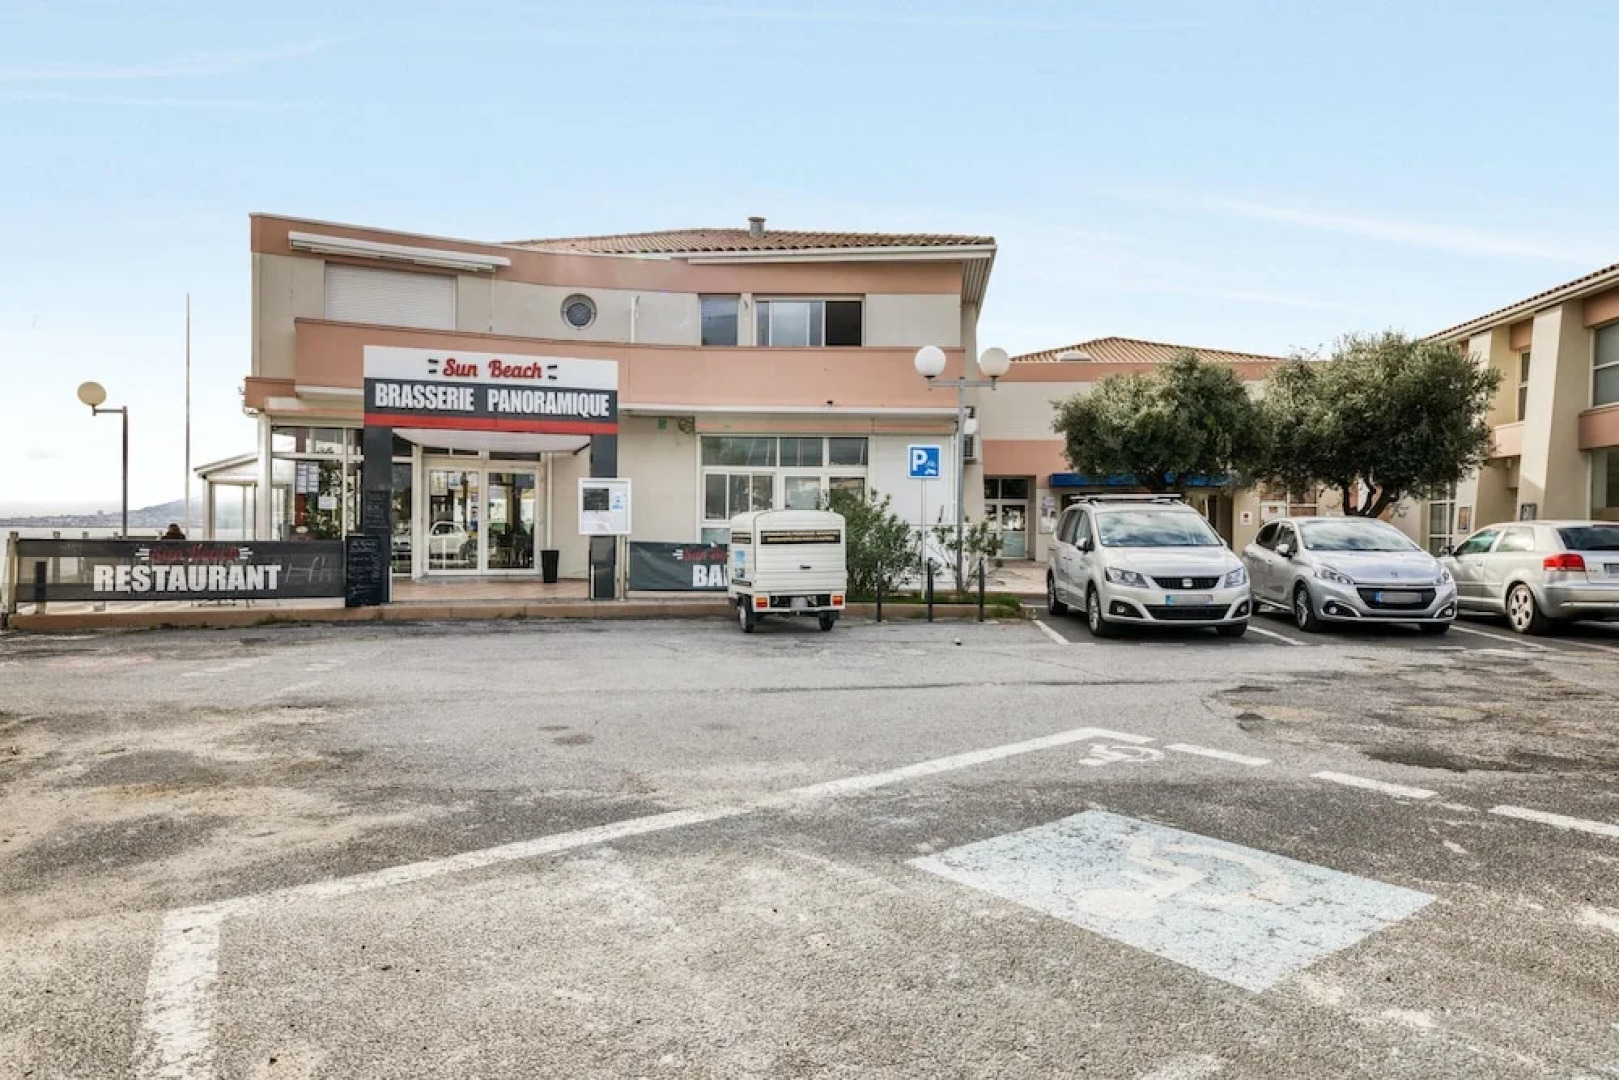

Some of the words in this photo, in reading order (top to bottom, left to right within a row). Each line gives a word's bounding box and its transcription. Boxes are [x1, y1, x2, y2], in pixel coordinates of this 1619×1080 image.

[443, 358, 478, 378] Sun
[488, 360, 543, 380] Beach
[375, 383, 475, 411] BRASSERIE
[487, 388, 609, 417] PANORAMIQUE
[912, 449, 928, 471] P
[93, 564, 282, 592] RESTAURANT
[692, 564, 728, 587] BA
